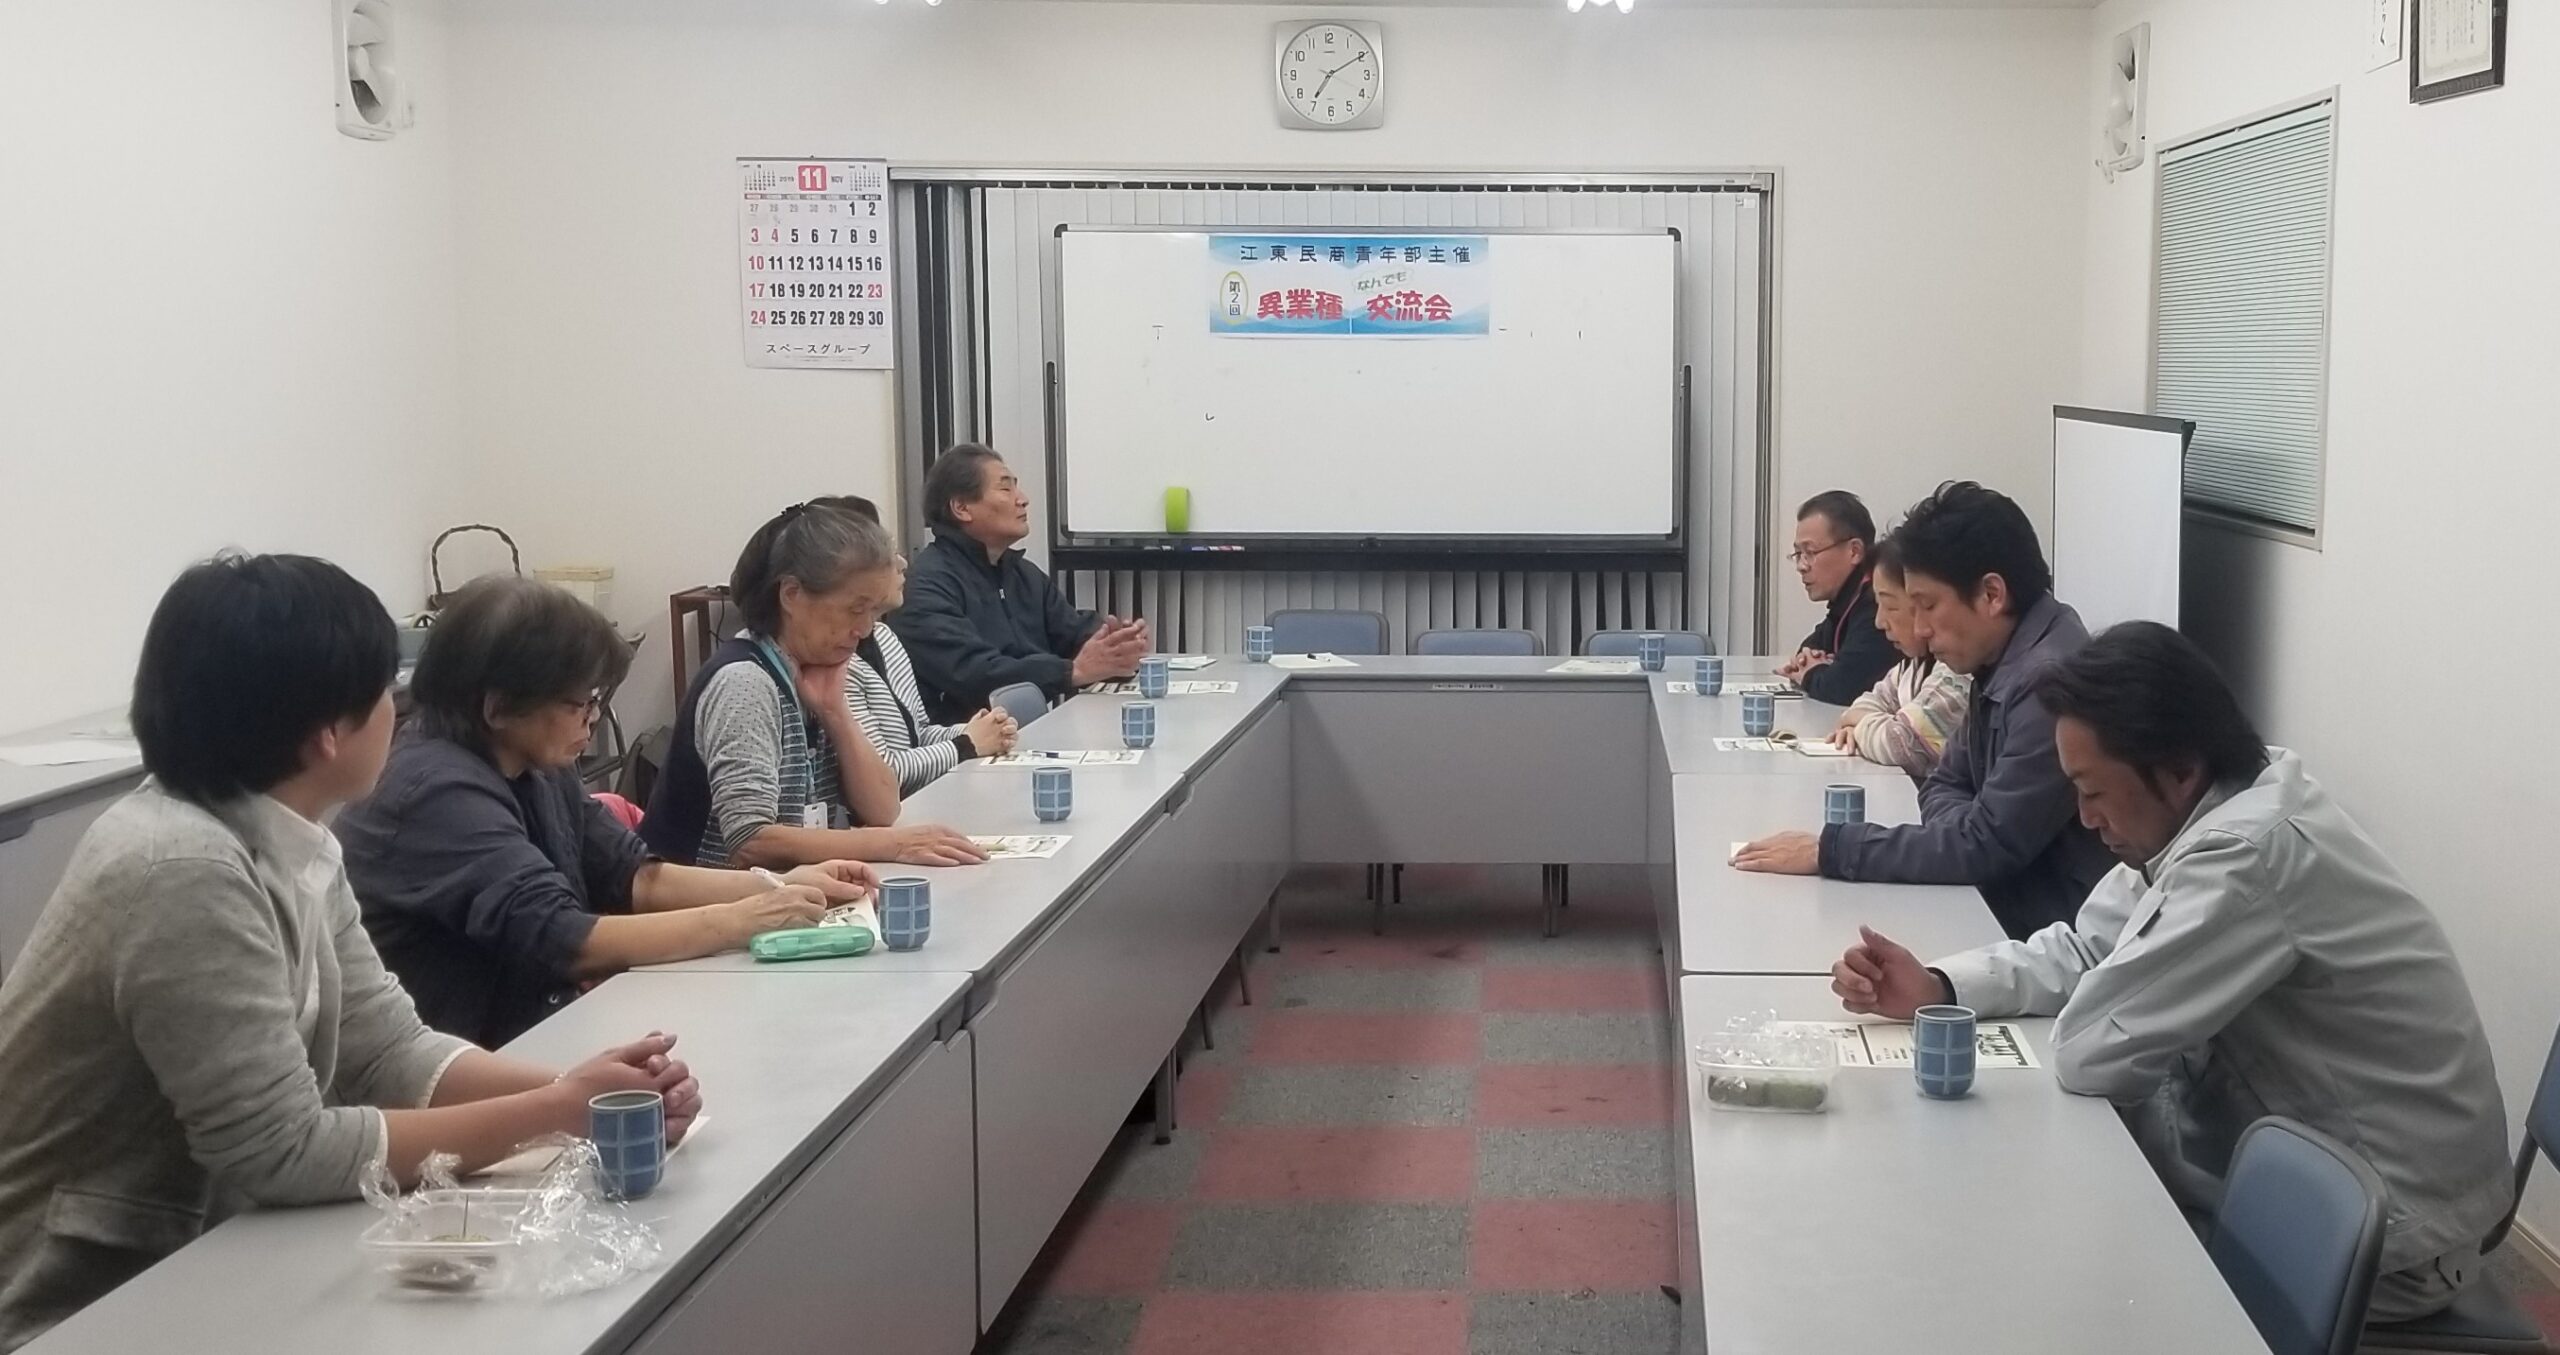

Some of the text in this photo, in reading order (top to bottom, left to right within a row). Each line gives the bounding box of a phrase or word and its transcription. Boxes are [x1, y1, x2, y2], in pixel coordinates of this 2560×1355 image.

[1325, 32, 1334, 44] 12
[1295, 50, 1305, 62] 10
[1290, 69, 1297, 81] 9
[1364, 69, 1371, 81] 3
[1296, 88, 1304, 99] 8
[1358, 88, 1365, 99] 4
[1311, 100, 1317, 112] 7
[1327, 106, 1335, 117] 6
[1346, 100, 1353, 112] 5
[801, 167, 823, 188] 11
[849, 201, 856, 216] 1
[868, 201, 877, 217] 2
[751, 228, 877, 243] 3 4 5 6 7 8 9
[1240, 245, 1471, 264] 江東民商青年部主催
[748, 256, 882, 271] 10 11 12 13 14 15 16
[1357, 270, 1407, 292] なんでも
[749, 283, 883, 298] 17 18 19 20 21 22 23
[1229, 281, 1241, 316] 第2回
[1257, 288, 1453, 322] 異業種 交流会
[751, 311, 884, 325] 24 25 26 27 28 29 30
